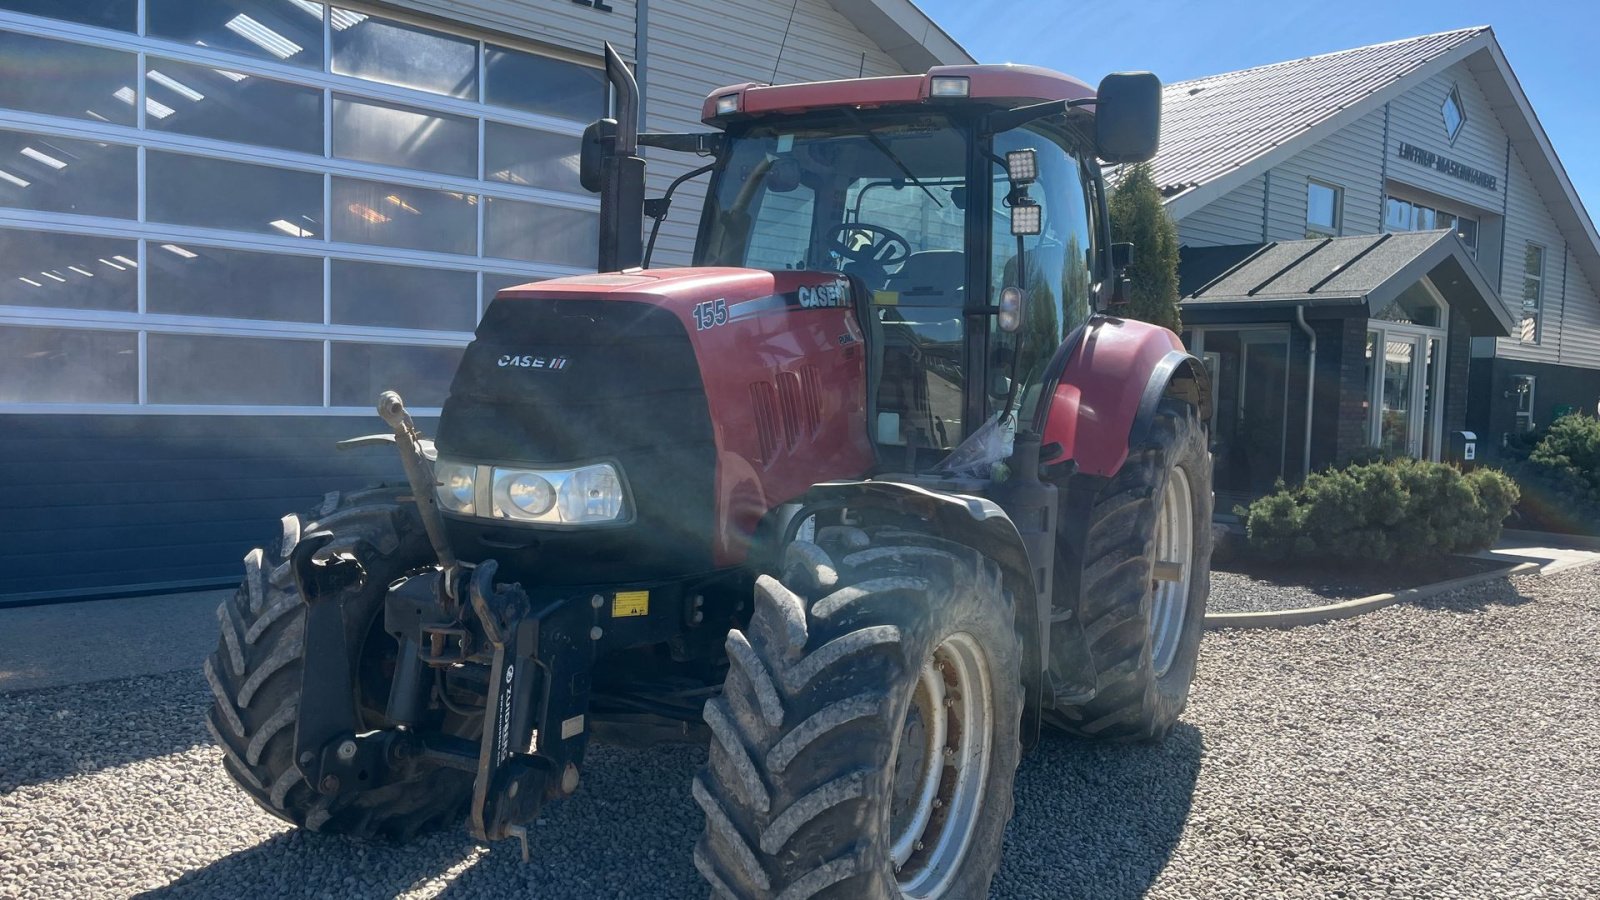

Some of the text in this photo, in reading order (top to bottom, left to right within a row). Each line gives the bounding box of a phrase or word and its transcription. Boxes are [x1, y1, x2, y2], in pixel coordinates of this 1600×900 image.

[799, 286, 836, 308] CASE
[693, 298, 729, 331] 155
[498, 355, 545, 368] CASE
[501, 685, 512, 762] ZUIDBERG
